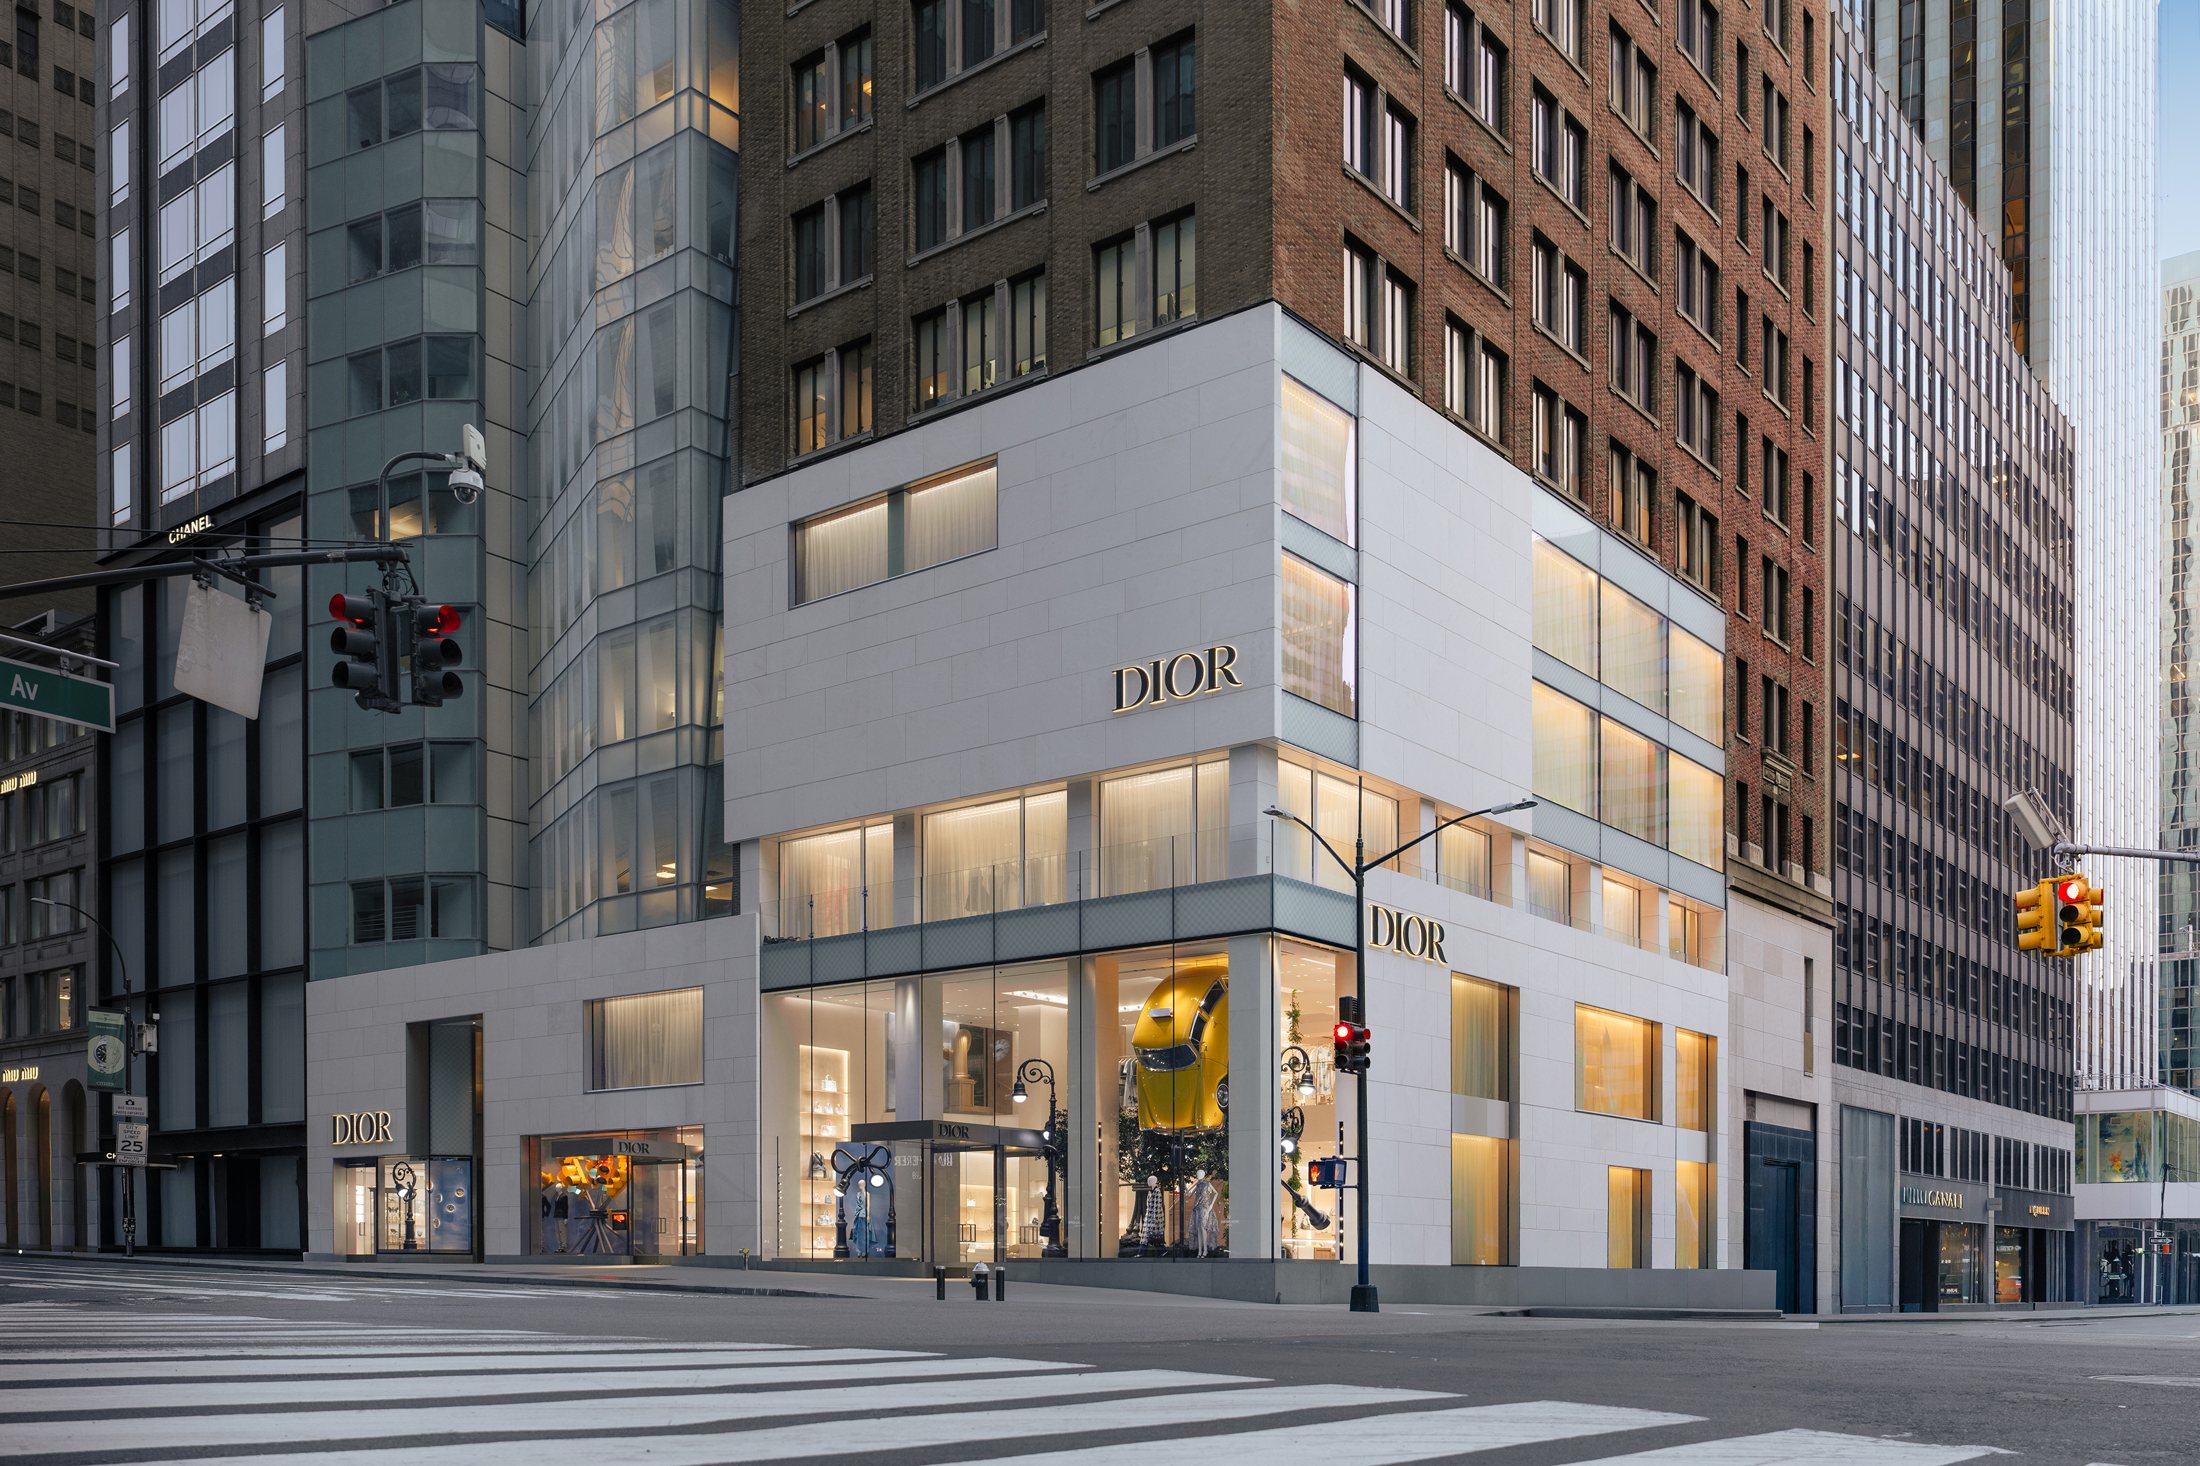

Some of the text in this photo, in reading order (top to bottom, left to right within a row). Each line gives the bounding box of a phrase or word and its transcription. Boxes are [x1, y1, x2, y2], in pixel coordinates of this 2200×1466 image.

[168, 514, 213, 544] CHANEL
[10, 673, 39, 701] Av
[1111, 644, 1243, 713] DIOR
[19, 770, 37, 788] MIU
[1368, 904, 1448, 965] DIOR
[2, 1066, 39, 1083] MIU MIU
[332, 1110, 394, 1145] DIOR
[938, 1123, 970, 1139] DIOR
[120, 1140, 143, 1153] 25
[618, 1141, 650, 1155] DIOR
[1928, 1190, 1964, 1209] CANALI
